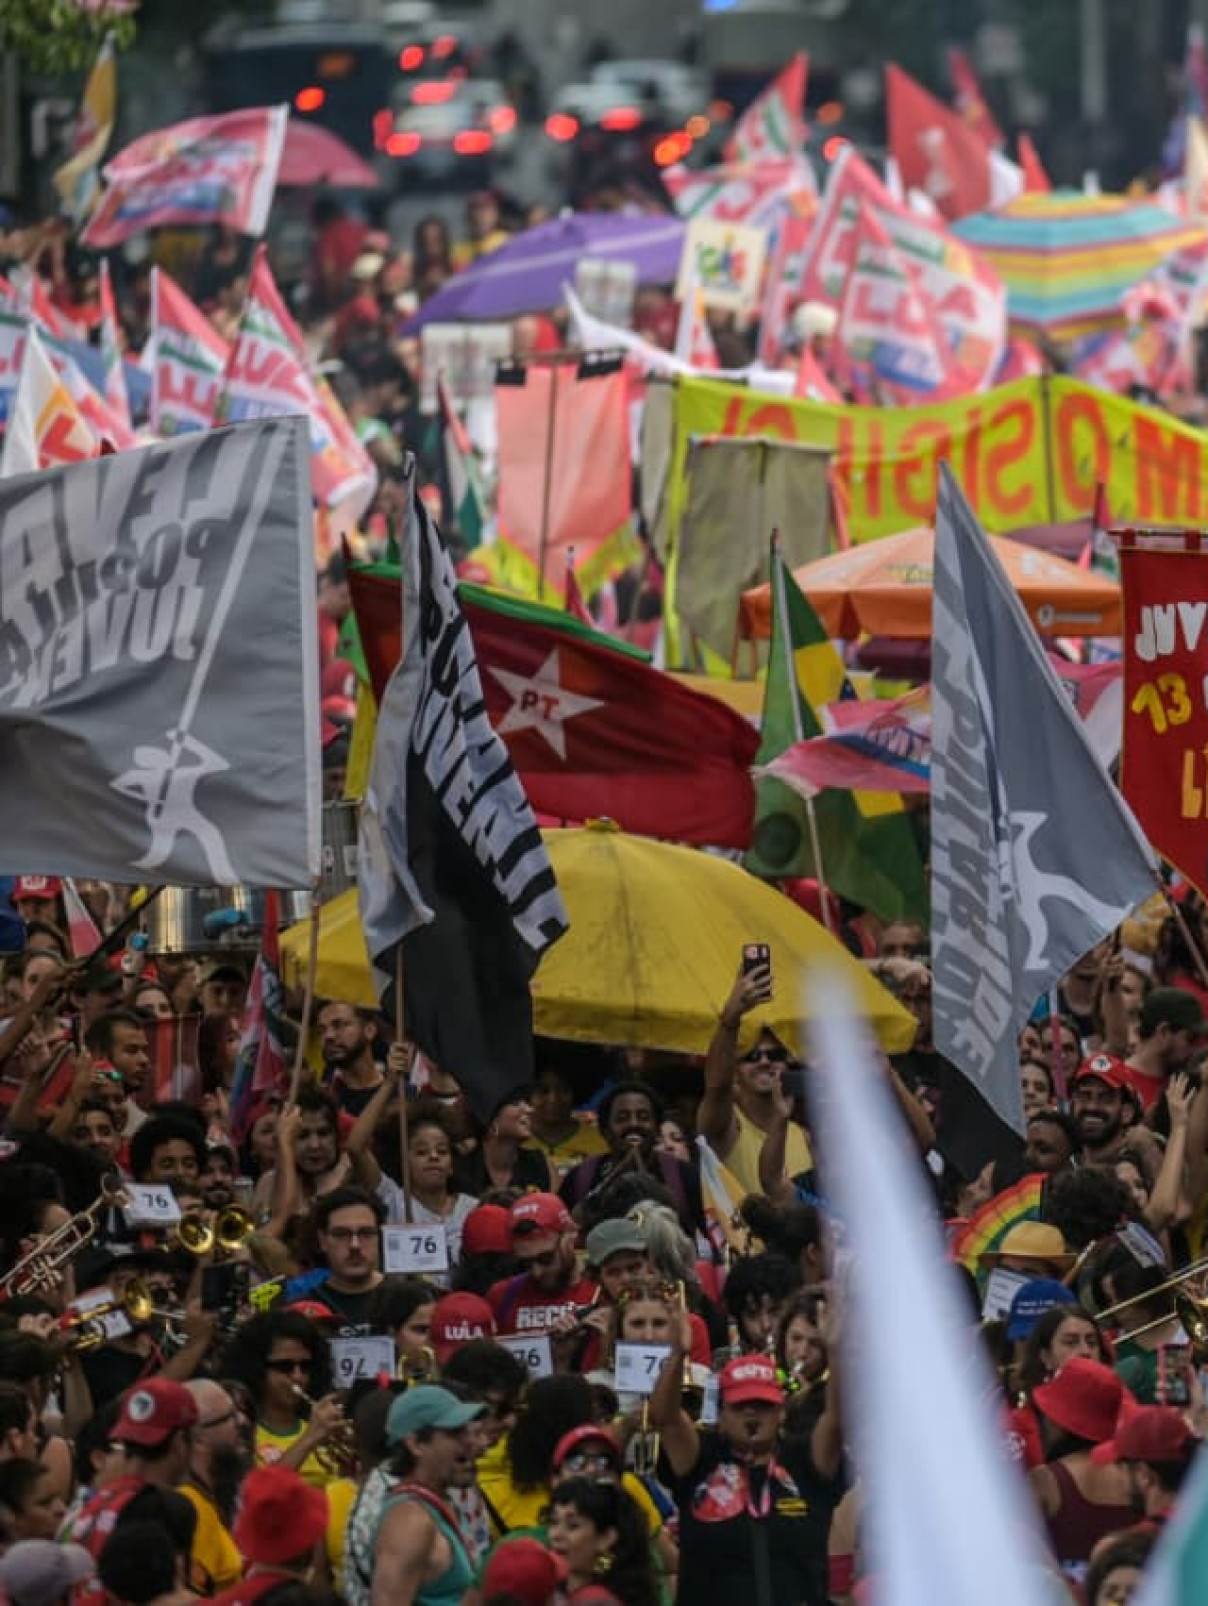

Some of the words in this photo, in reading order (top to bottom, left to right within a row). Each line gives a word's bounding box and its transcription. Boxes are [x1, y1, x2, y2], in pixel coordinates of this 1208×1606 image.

[520, 691, 560, 721] PT
[1132, 673, 1192, 734] 13
[143, 1193, 169, 1210] 76
[410, 1236, 437, 1255] 76
[445, 1321, 484, 1340] LULA
[642, 1355, 665, 1375] 7
